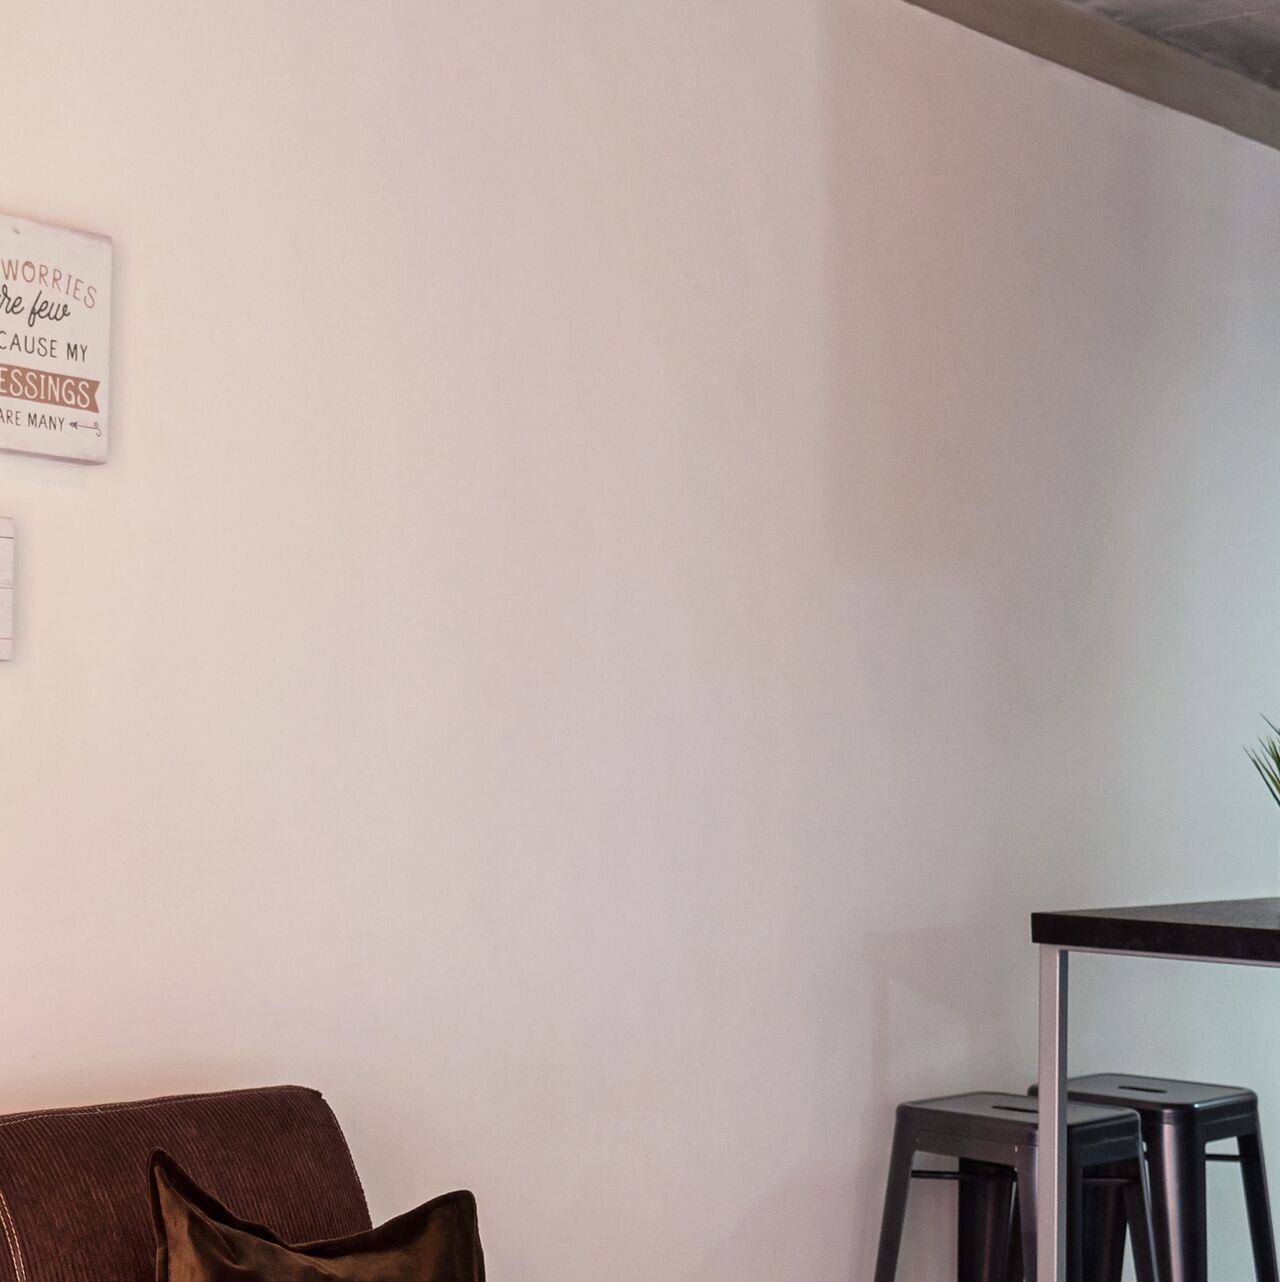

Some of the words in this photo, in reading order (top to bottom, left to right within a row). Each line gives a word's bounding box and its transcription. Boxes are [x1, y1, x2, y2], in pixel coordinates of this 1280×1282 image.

[1, 259, 98, 309] WORRIES
[27, 290, 72, 328] few
[66, 342, 88, 363] MY
[28, 412, 65, 431] MANY
